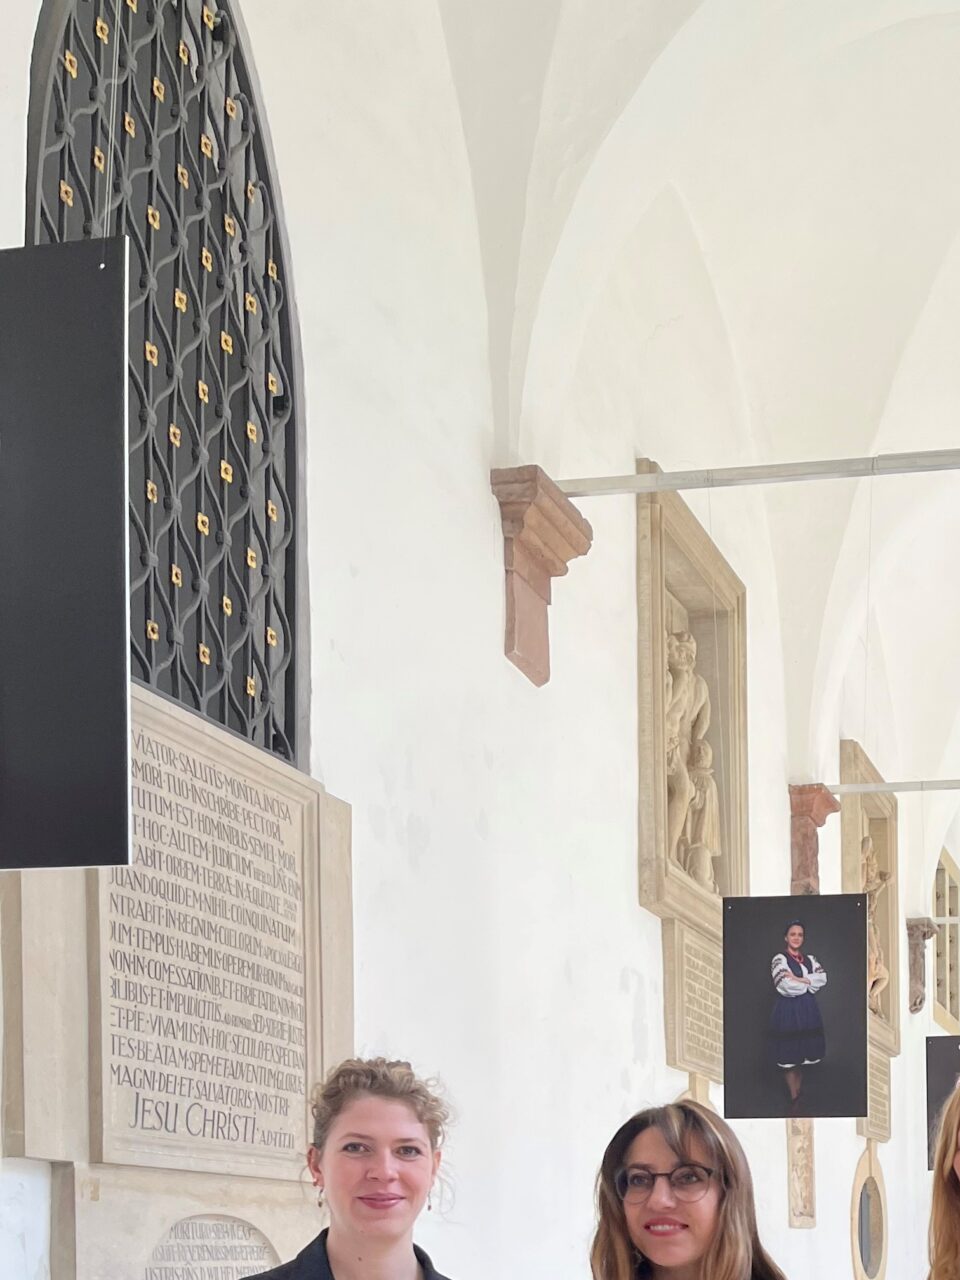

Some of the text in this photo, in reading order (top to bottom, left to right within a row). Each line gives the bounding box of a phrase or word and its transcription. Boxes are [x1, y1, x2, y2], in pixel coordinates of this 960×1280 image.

[175, 802, 194, 829] EST
[142, 816, 166, 845] HOC
[168, 827, 208, 860] AUTEM
[165, 854, 199, 884] ORBEM
[136, 927, 174, 955] TEMPUS
[125, 1005, 144, 1032] PIE
[149, 1014, 198, 1043] VIVAMUS
[210, 1028, 228, 1051] HOC
[136, 1039, 187, 1068] BEATAM
[110, 1063, 155, 1090] MAGNI
[157, 1072, 177, 1095] DEI
[128, 1092, 178, 1133] JESU
